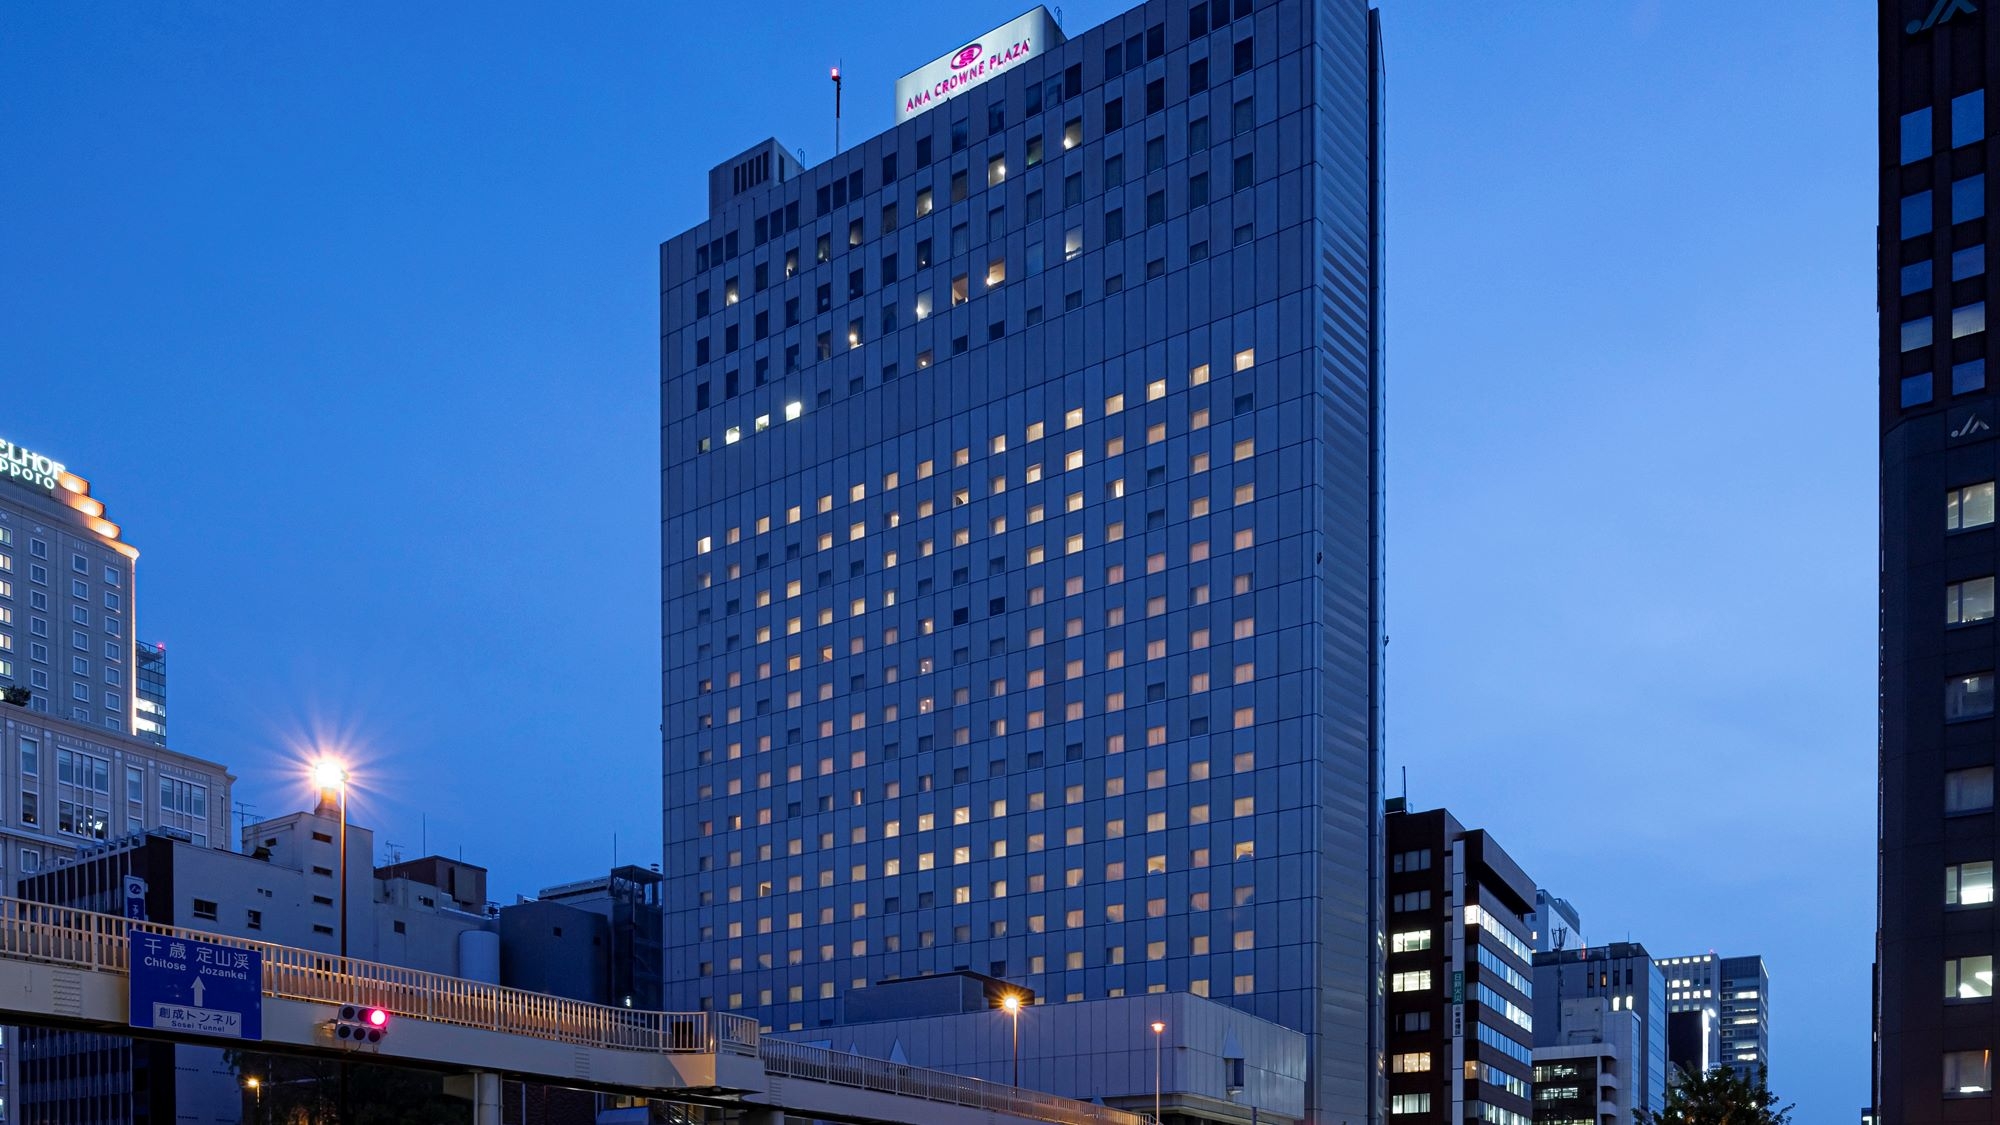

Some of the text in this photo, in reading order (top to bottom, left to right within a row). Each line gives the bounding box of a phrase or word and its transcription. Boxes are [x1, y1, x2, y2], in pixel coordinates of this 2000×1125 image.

[905, 40, 1029, 112] ANA CROWNE PLAZA
[144, 938, 250, 970] 千歳 定山渓
[144, 956, 247, 980] Chitose Jozankei
[159, 1006, 237, 1026] 創成トンネル
[171, 1020, 225, 1032] Sosei Tunnel
